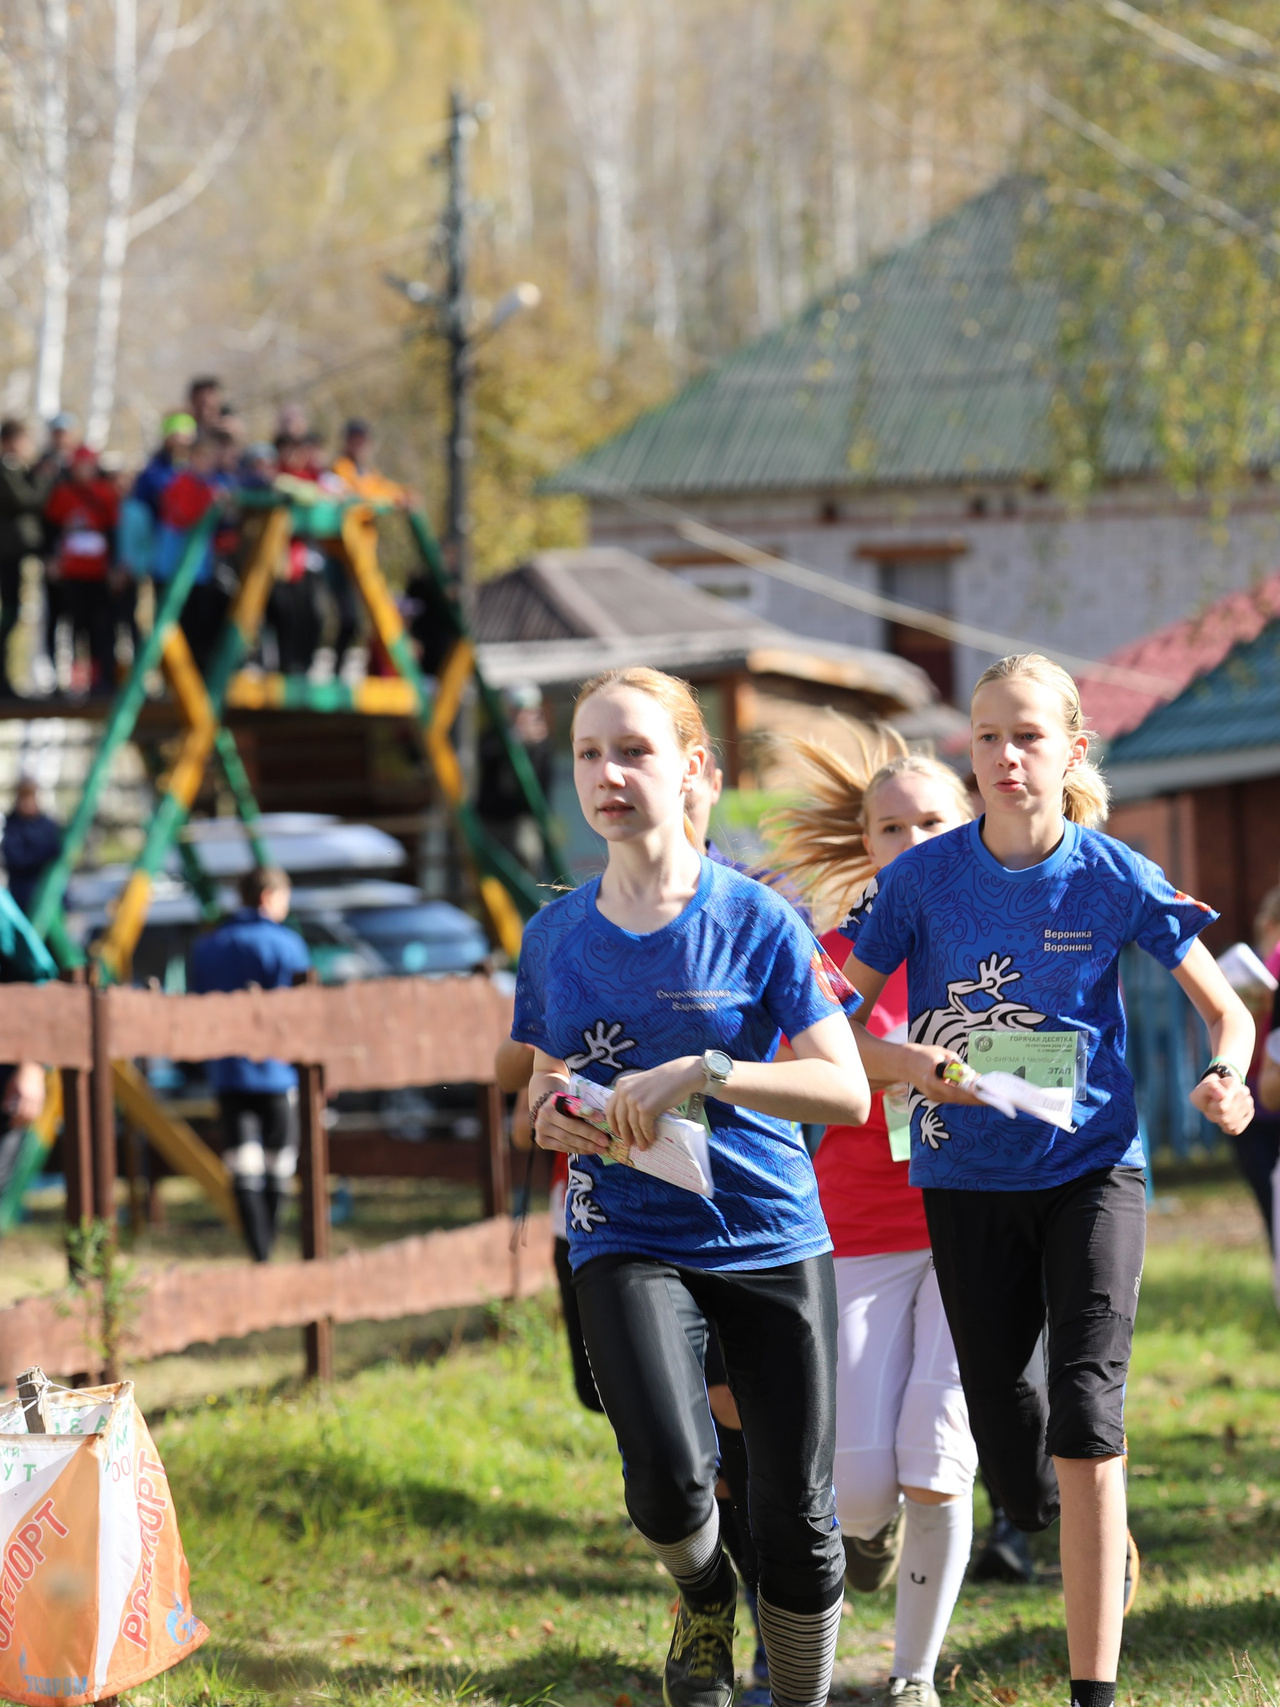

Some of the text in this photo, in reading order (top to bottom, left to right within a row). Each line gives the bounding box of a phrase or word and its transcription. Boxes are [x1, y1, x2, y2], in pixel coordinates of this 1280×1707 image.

[1044, 929, 1092, 940] Вероника
[1044, 942, 1092, 953] Воронина
[1047, 1067, 1071, 1075] ЭТАП
